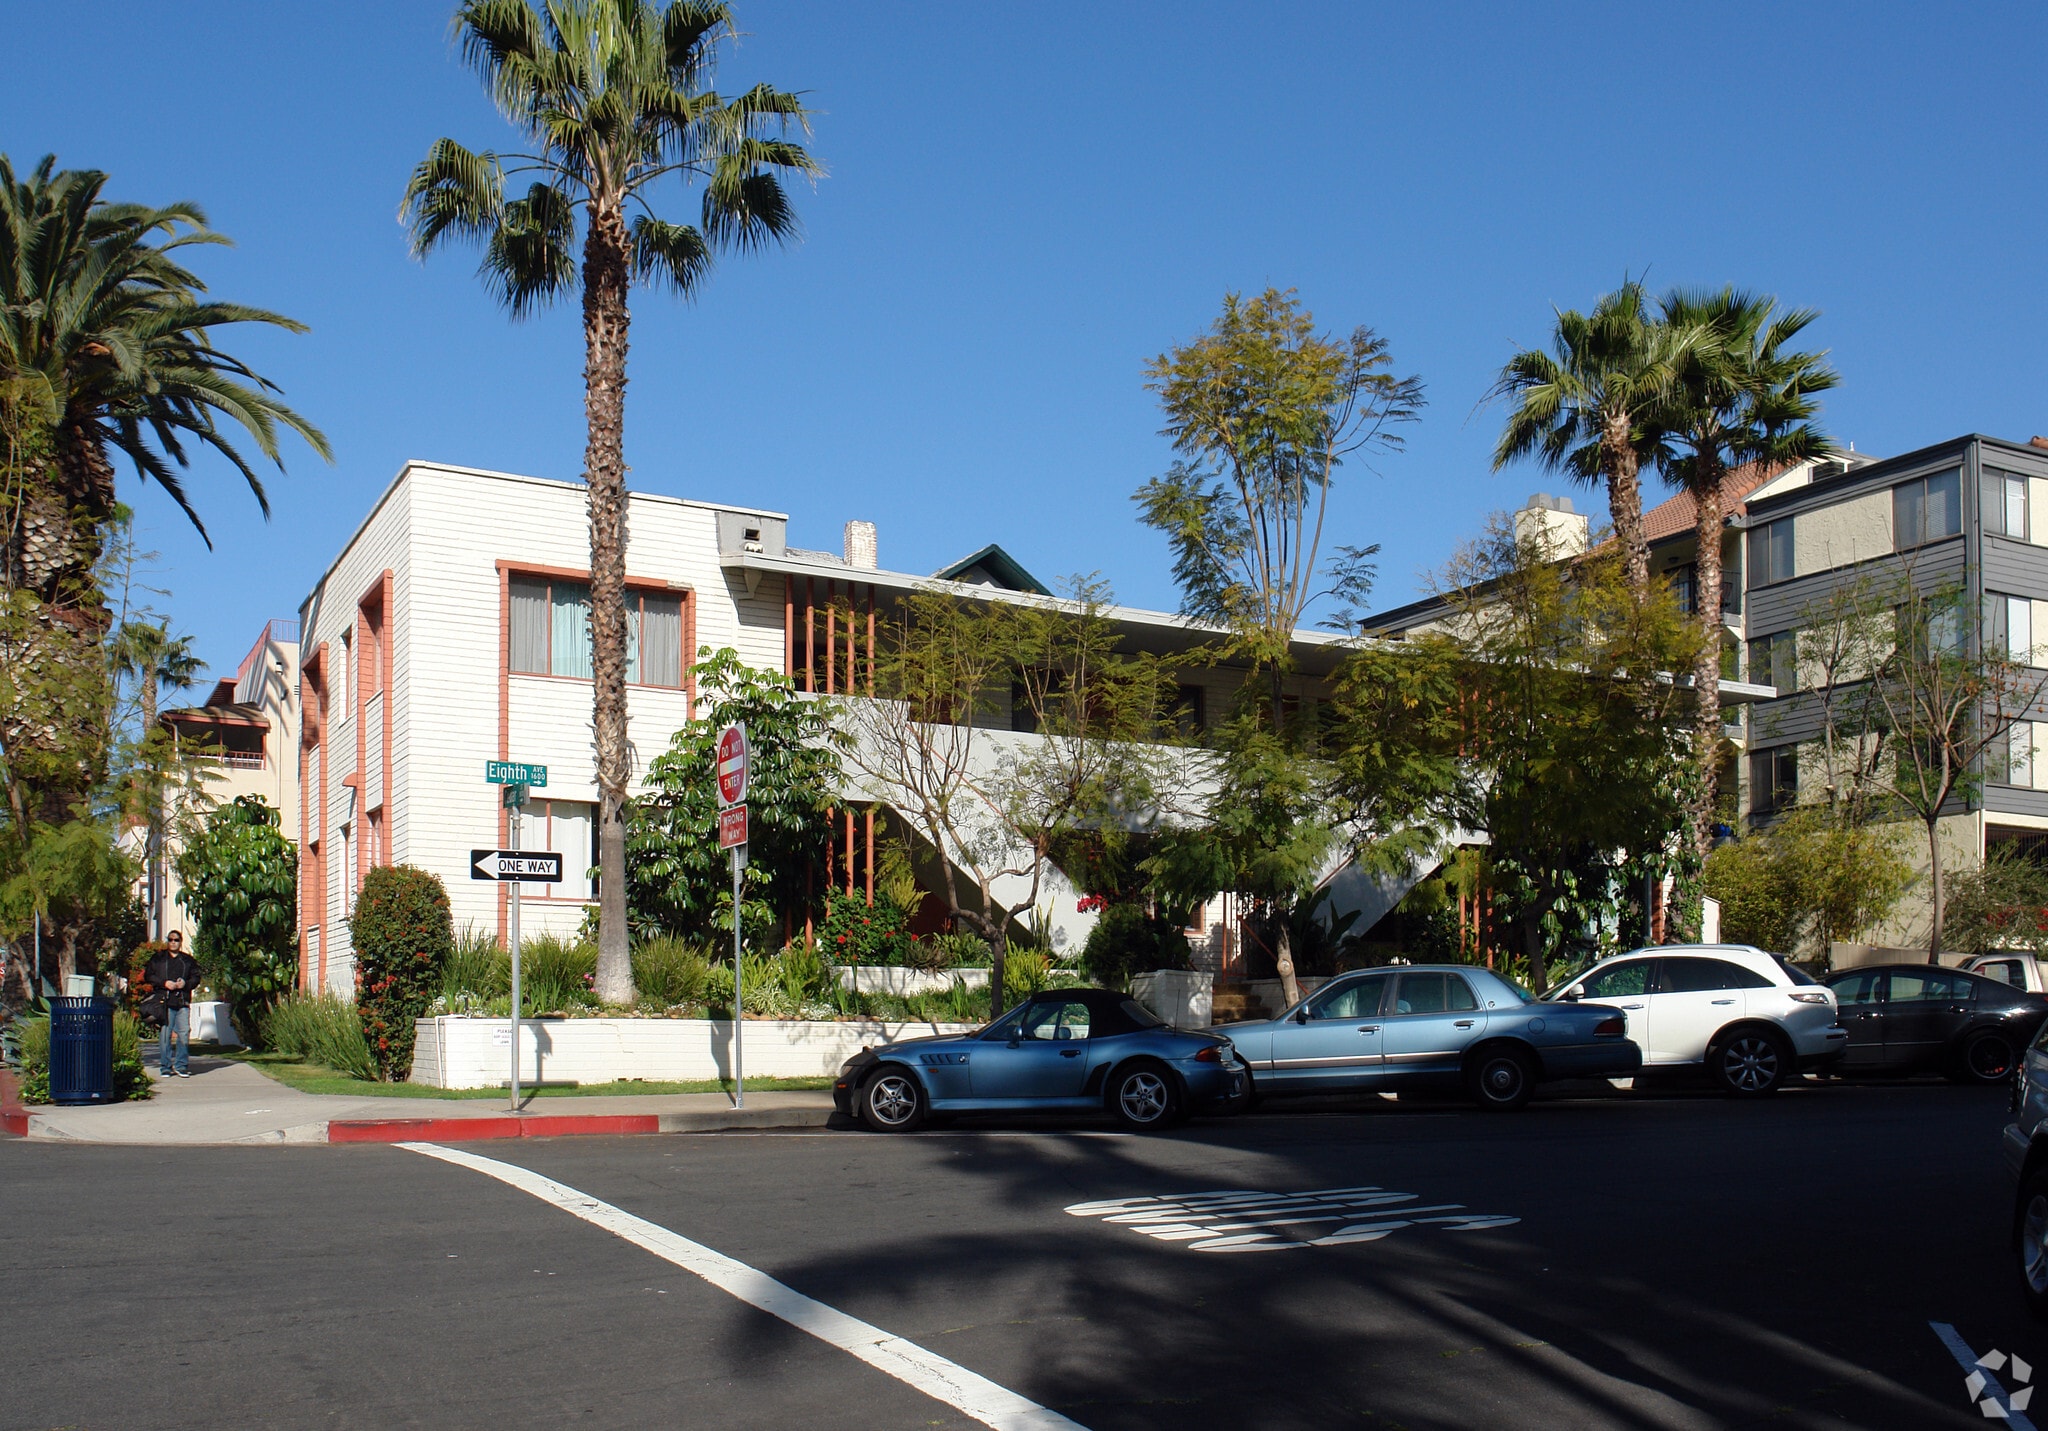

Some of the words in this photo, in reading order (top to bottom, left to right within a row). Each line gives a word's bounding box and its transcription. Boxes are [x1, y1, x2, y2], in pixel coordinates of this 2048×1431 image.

[721, 745, 729, 758] DO
[731, 739, 741, 754] NOT
[489, 762, 527, 783] Eighth
[532, 766, 544, 774] AVE
[724, 774, 740, 790] ENTER
[723, 811, 744, 826] WRONG
[728, 829, 740, 841] WAY
[498, 860, 523, 872] ONE
[528, 861, 553, 873] WAY
[1063, 1186, 1521, 1253] STOP
